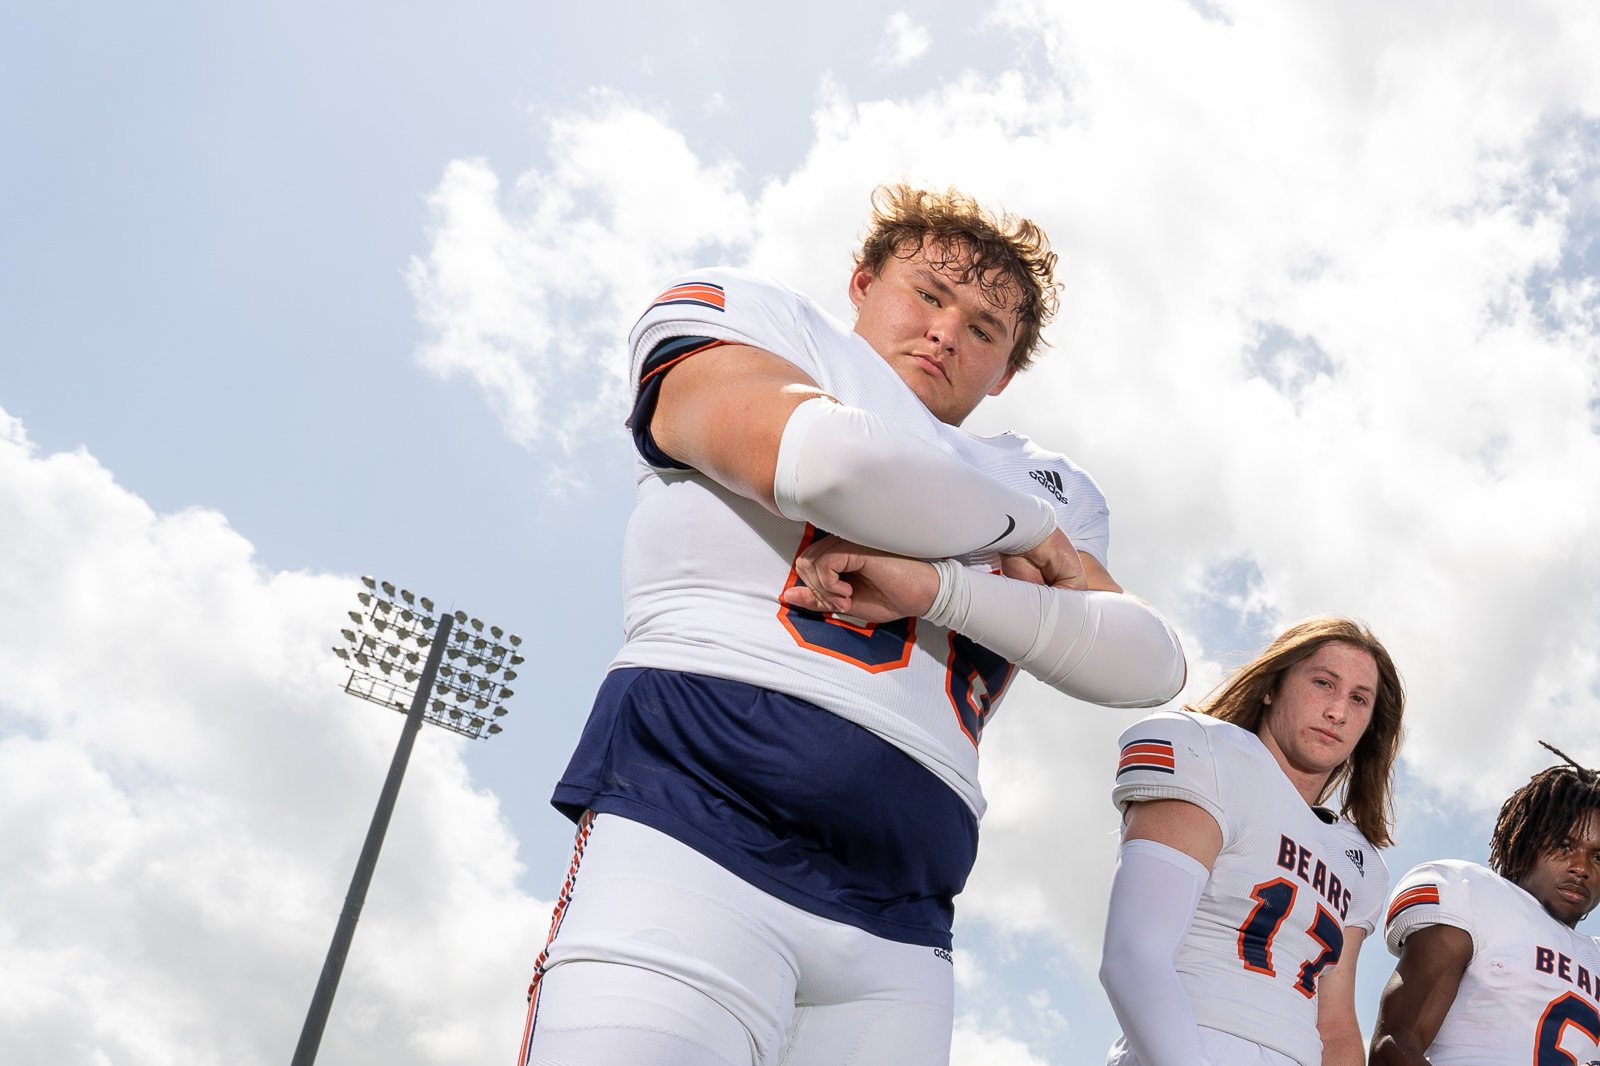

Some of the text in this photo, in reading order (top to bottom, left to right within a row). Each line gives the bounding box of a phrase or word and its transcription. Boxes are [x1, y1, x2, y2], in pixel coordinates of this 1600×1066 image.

[1028, 470, 1068, 505] adidas
[1276, 834, 1352, 922] BEARS
[1236, 876, 1344, 999] 17
